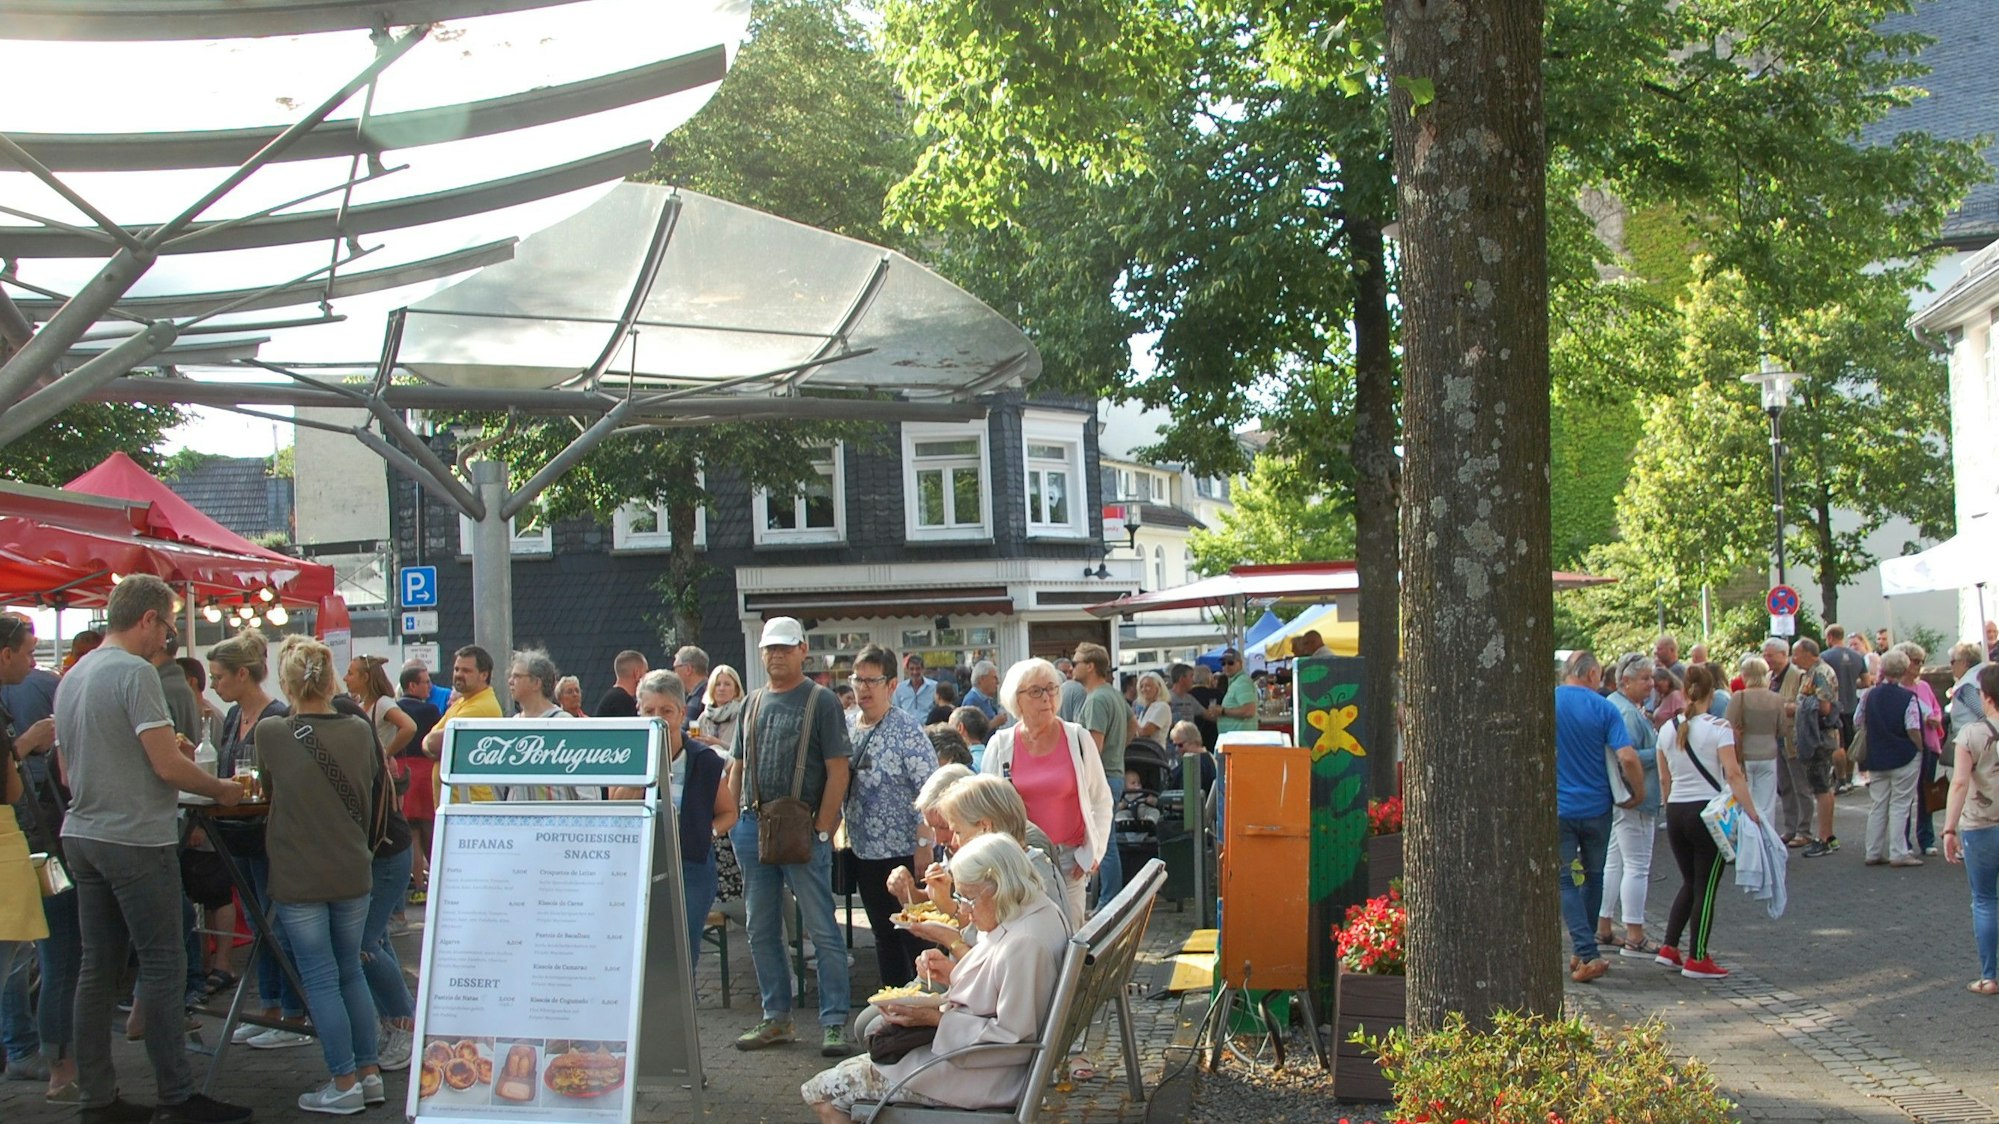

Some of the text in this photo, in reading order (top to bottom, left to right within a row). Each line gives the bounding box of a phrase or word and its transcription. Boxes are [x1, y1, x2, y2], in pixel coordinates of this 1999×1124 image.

[406, 572, 426, 602] P
[468, 734, 632, 774] Eat Portuguese
[458, 838, 514, 850] BIFANAS
[535, 832, 640, 844] PORTUGIESISCHE
[563, 849, 611, 860] SNACKS
[449, 977, 501, 989] DESSERT
